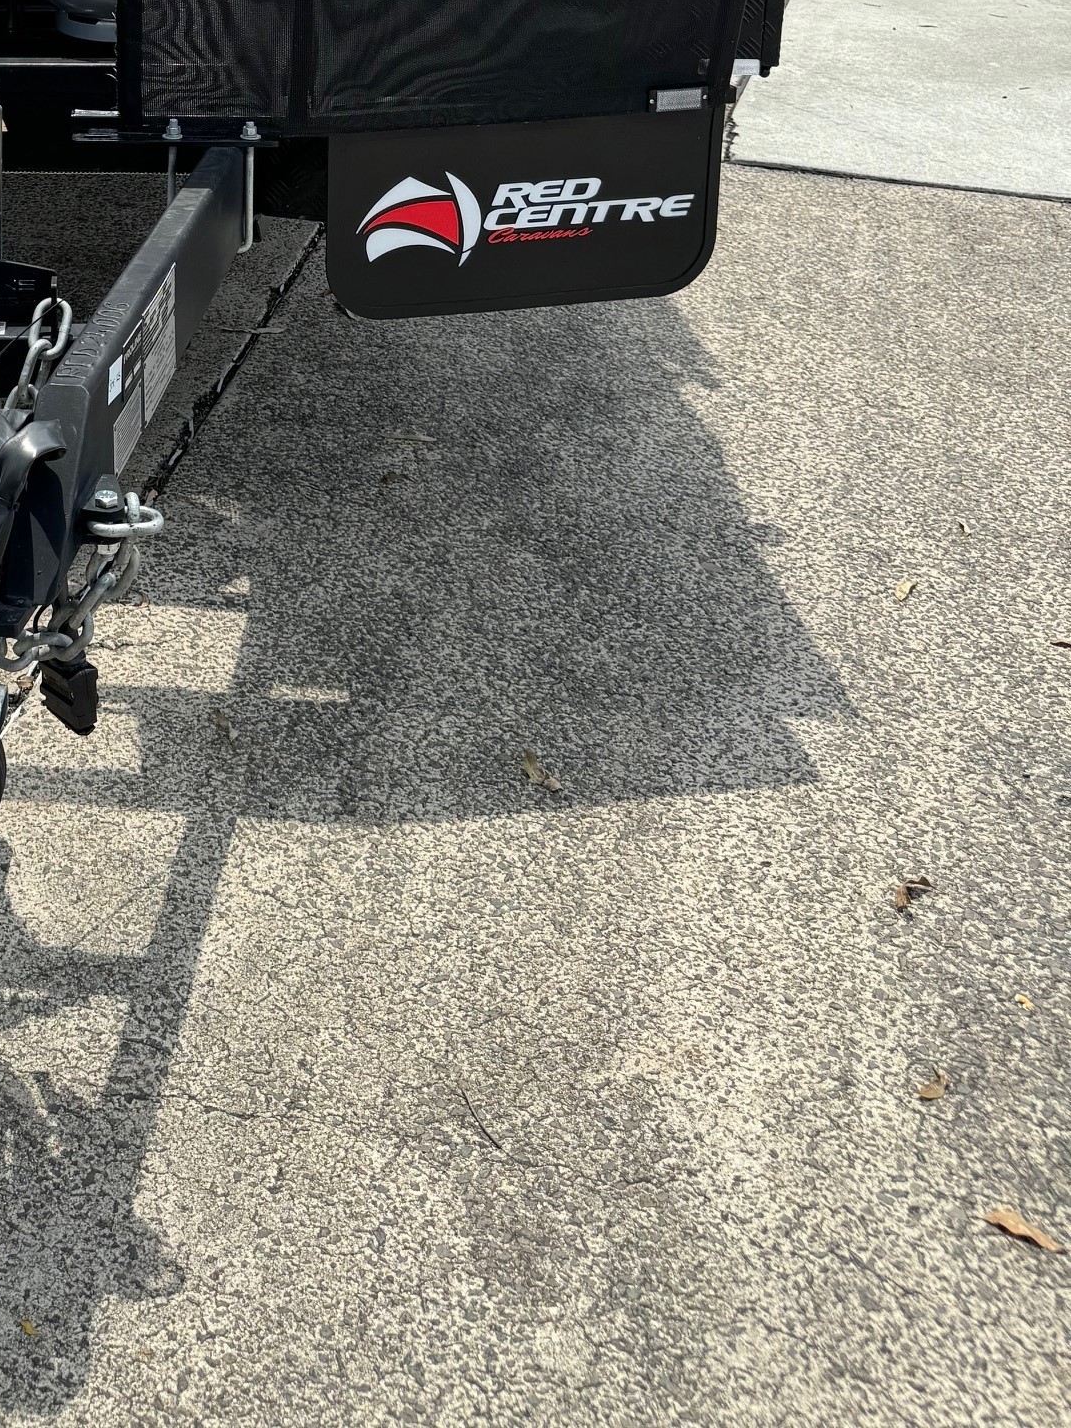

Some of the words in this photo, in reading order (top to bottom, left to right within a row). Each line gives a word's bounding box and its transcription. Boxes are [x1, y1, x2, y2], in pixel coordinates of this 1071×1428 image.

[491, 177, 603, 208] RED
[483, 193, 695, 230] CENTRE
[487, 226, 593, 245] Caravans
